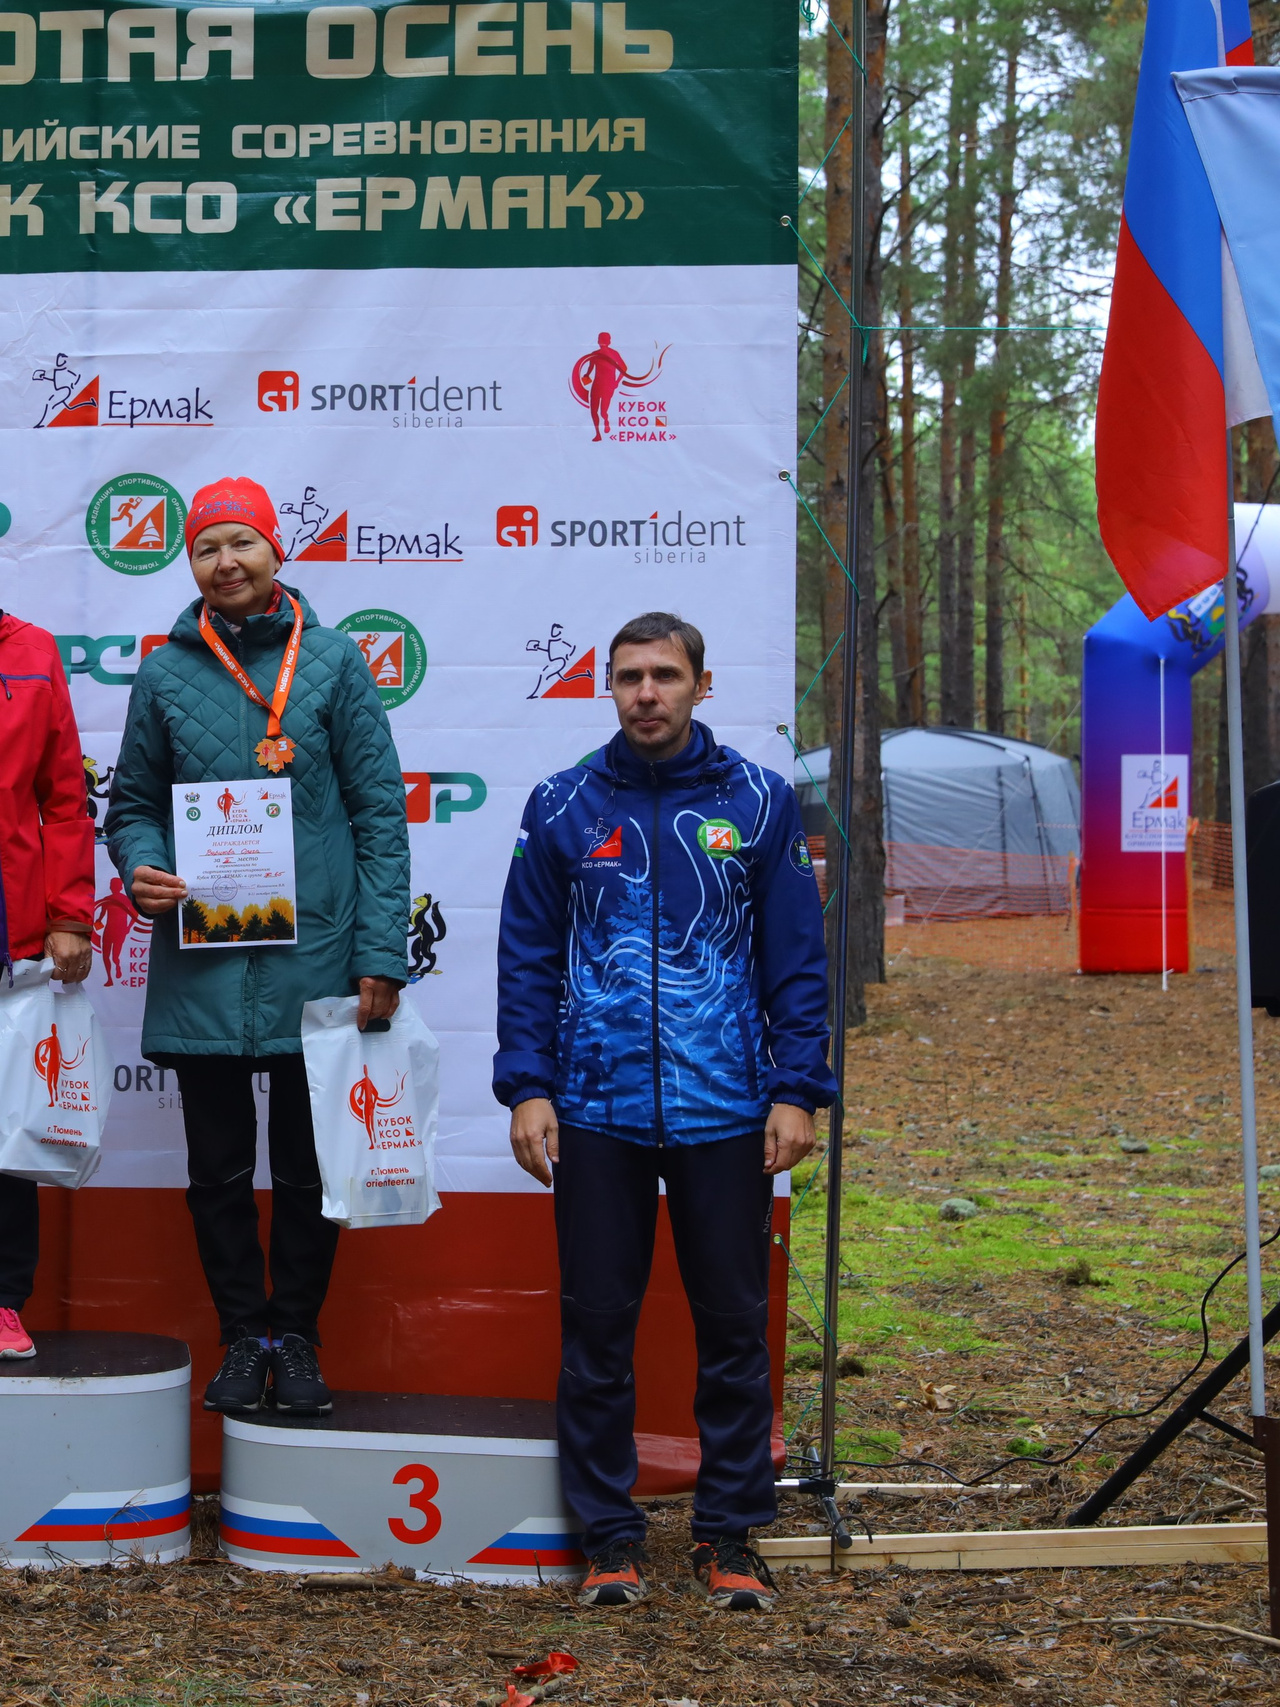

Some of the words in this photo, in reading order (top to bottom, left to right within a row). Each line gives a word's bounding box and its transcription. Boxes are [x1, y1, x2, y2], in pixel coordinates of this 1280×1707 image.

[305, 0, 675, 80] ОСЕНЬ
[231, 117, 646, 159] СОРЕВНОВАНИЯ
[78, 180, 238, 234] КСО
[273, 174, 645, 232] «ЕРМАК»
[311, 375, 503, 412] SPORTident
[106, 387, 214, 428] Ермак
[618, 401, 667, 413] КУБОК
[392, 413, 464, 429] siberia
[618, 416, 650, 427] КСО
[609, 430, 677, 443] «ЕРМАК»
[118, 478, 169, 494] СПОРТИВНОГО
[91, 486, 114, 525] ФЕДЕРАЦИЯ
[164, 498, 184, 560] ОРИЕНТИРОВАНИЯ
[551, 510, 746, 548] SPORTident
[91, 529, 110, 559] ОБЛАСТИ
[356, 524, 464, 564] Ермак
[634, 548, 706, 564] siberia
[114, 560, 159, 571] ТЮМЕНСКОЙ
[355, 613, 406, 630] СПОРТИВНОГО
[401, 633, 422, 696] ОРИЕНТИРОВАНИЯ
[277, 740, 288, 751] 3
[206, 824, 263, 837] ДИПЛОМ
[129, 962, 148, 973] КС
[61, 1080, 90, 1089] КУБОК
[61, 1090, 78, 1100] КСО
[58, 1101, 98, 1112] «ЕРМАК»
[377, 1115, 413, 1127] КУБОК
[379, 1128, 401, 1139] КСО
[40, 1136, 88, 1148] orienteer.ru
[376, 1138, 423, 1150] «ЕРМАК»
[365, 1177, 416, 1188] orienteer.ru
[387, 1463, 442, 1545] 3
